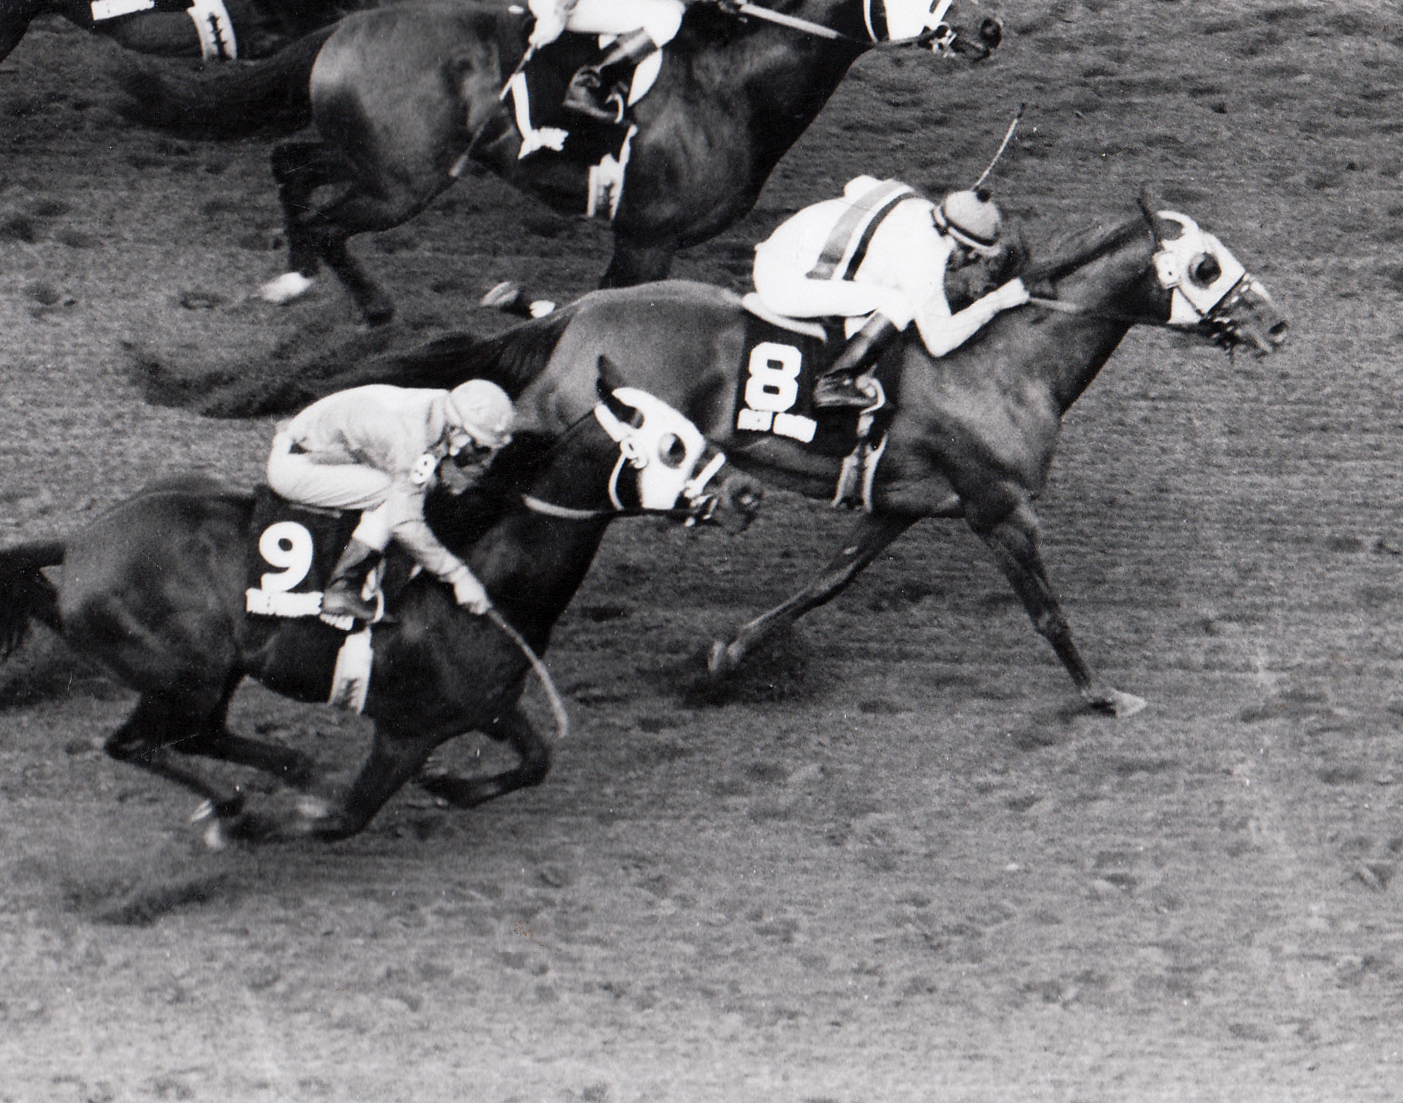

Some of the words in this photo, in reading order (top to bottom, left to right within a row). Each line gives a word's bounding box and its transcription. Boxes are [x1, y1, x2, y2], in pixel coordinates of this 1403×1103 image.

[744, 341, 802, 413] 8
[412, 454, 436, 485] 9
[258, 520, 314, 592] 9
